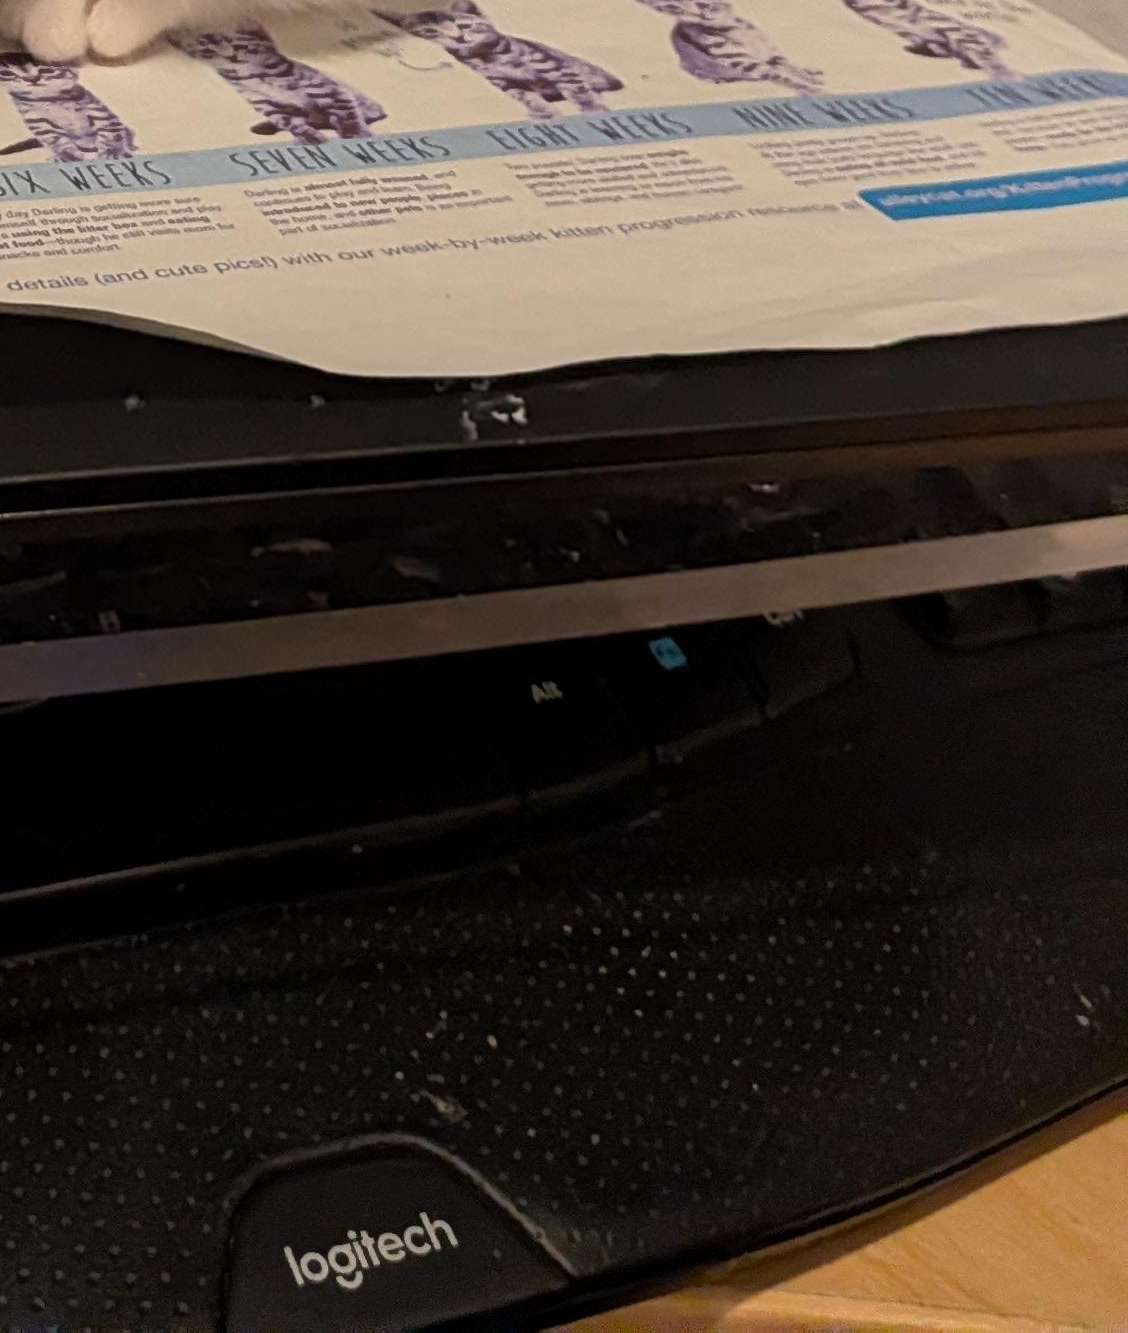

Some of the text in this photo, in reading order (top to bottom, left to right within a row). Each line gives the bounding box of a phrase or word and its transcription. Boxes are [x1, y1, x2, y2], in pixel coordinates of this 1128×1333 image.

[485, 112, 694, 151] EIGHT WEEKS
[229, 135, 452, 177] SEVEN WEEKS
[59, 159, 172, 191] WEEKS
[5, 208, 29, 221] day
[32, 205, 78, 217] Darling
[11, 227, 52, 240] using
[54, 224, 78, 236] the
[167, 213, 212, 227] eating
[5, 273, 89, 292] details
[94, 269, 150, 287] (and
[154, 263, 209, 279] cute
[214, 254, 278, 276] pics!)
[281, 250, 333, 268] with
[337, 247, 375, 262] our
[380, 228, 548, 260] week-by-week
[548, 222, 616, 240] kitten
[617, 208, 746, 236] progression
[530, 679, 565, 705] Alt
[283, 1211, 459, 1290] logitech
